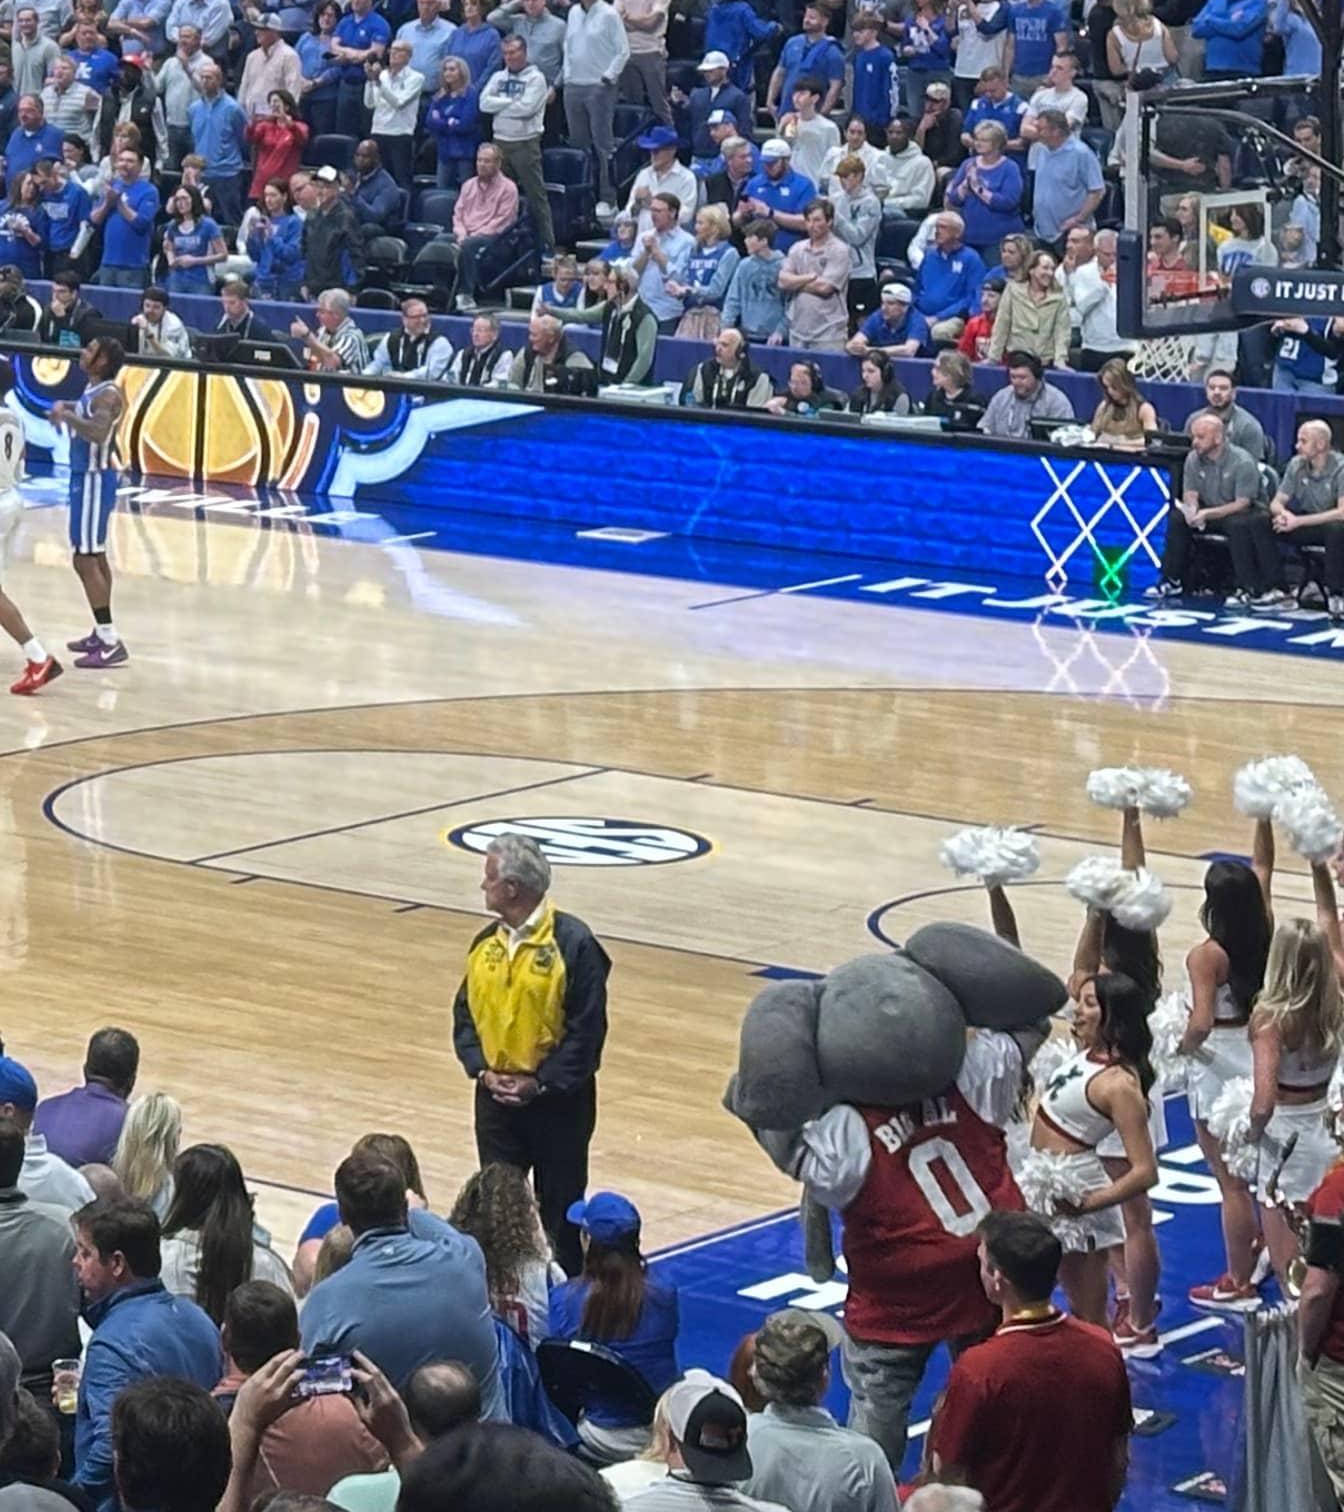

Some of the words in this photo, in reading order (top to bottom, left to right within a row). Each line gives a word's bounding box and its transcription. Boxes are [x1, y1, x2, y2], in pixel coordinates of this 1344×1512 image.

[1275, 281, 1295, 301] IT
[1298, 283, 1339, 304] JUST
[3, 430, 14, 461] 8
[858, 575, 996, 602] IT
[982, 596, 1293, 638] JUST
[908, 1137, 993, 1237] 0
